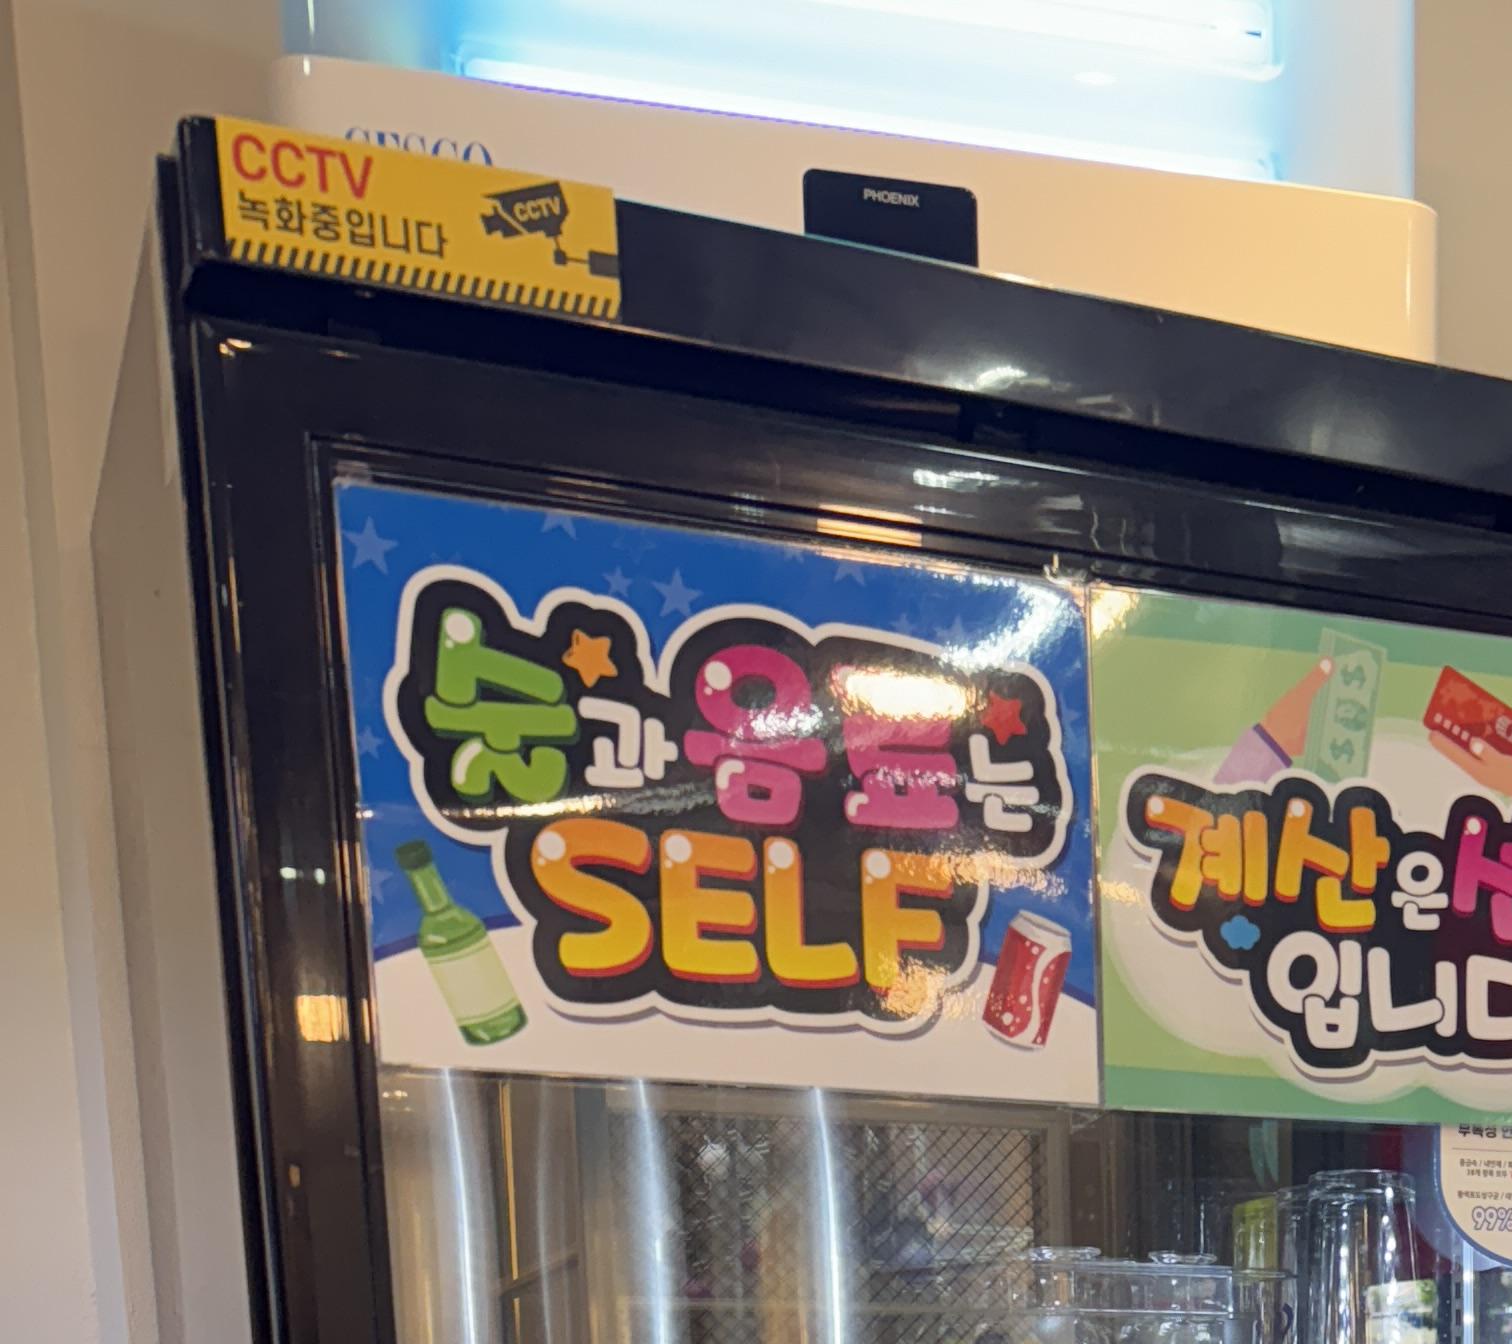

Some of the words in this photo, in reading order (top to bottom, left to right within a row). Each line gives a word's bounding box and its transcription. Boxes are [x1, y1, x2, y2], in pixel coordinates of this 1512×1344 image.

[231, 133, 373, 199] CCTV
[863, 188, 920, 208] PHOENIX
[237, 189, 448, 259] 녹화중입니다
[514, 196, 561, 223] CCTV
[425, 607, 680, 803] 술과
[684, 643, 1036, 833] 음료는
[1145, 796, 1449, 933] 계산은
[531, 817, 955, 996] SELF
